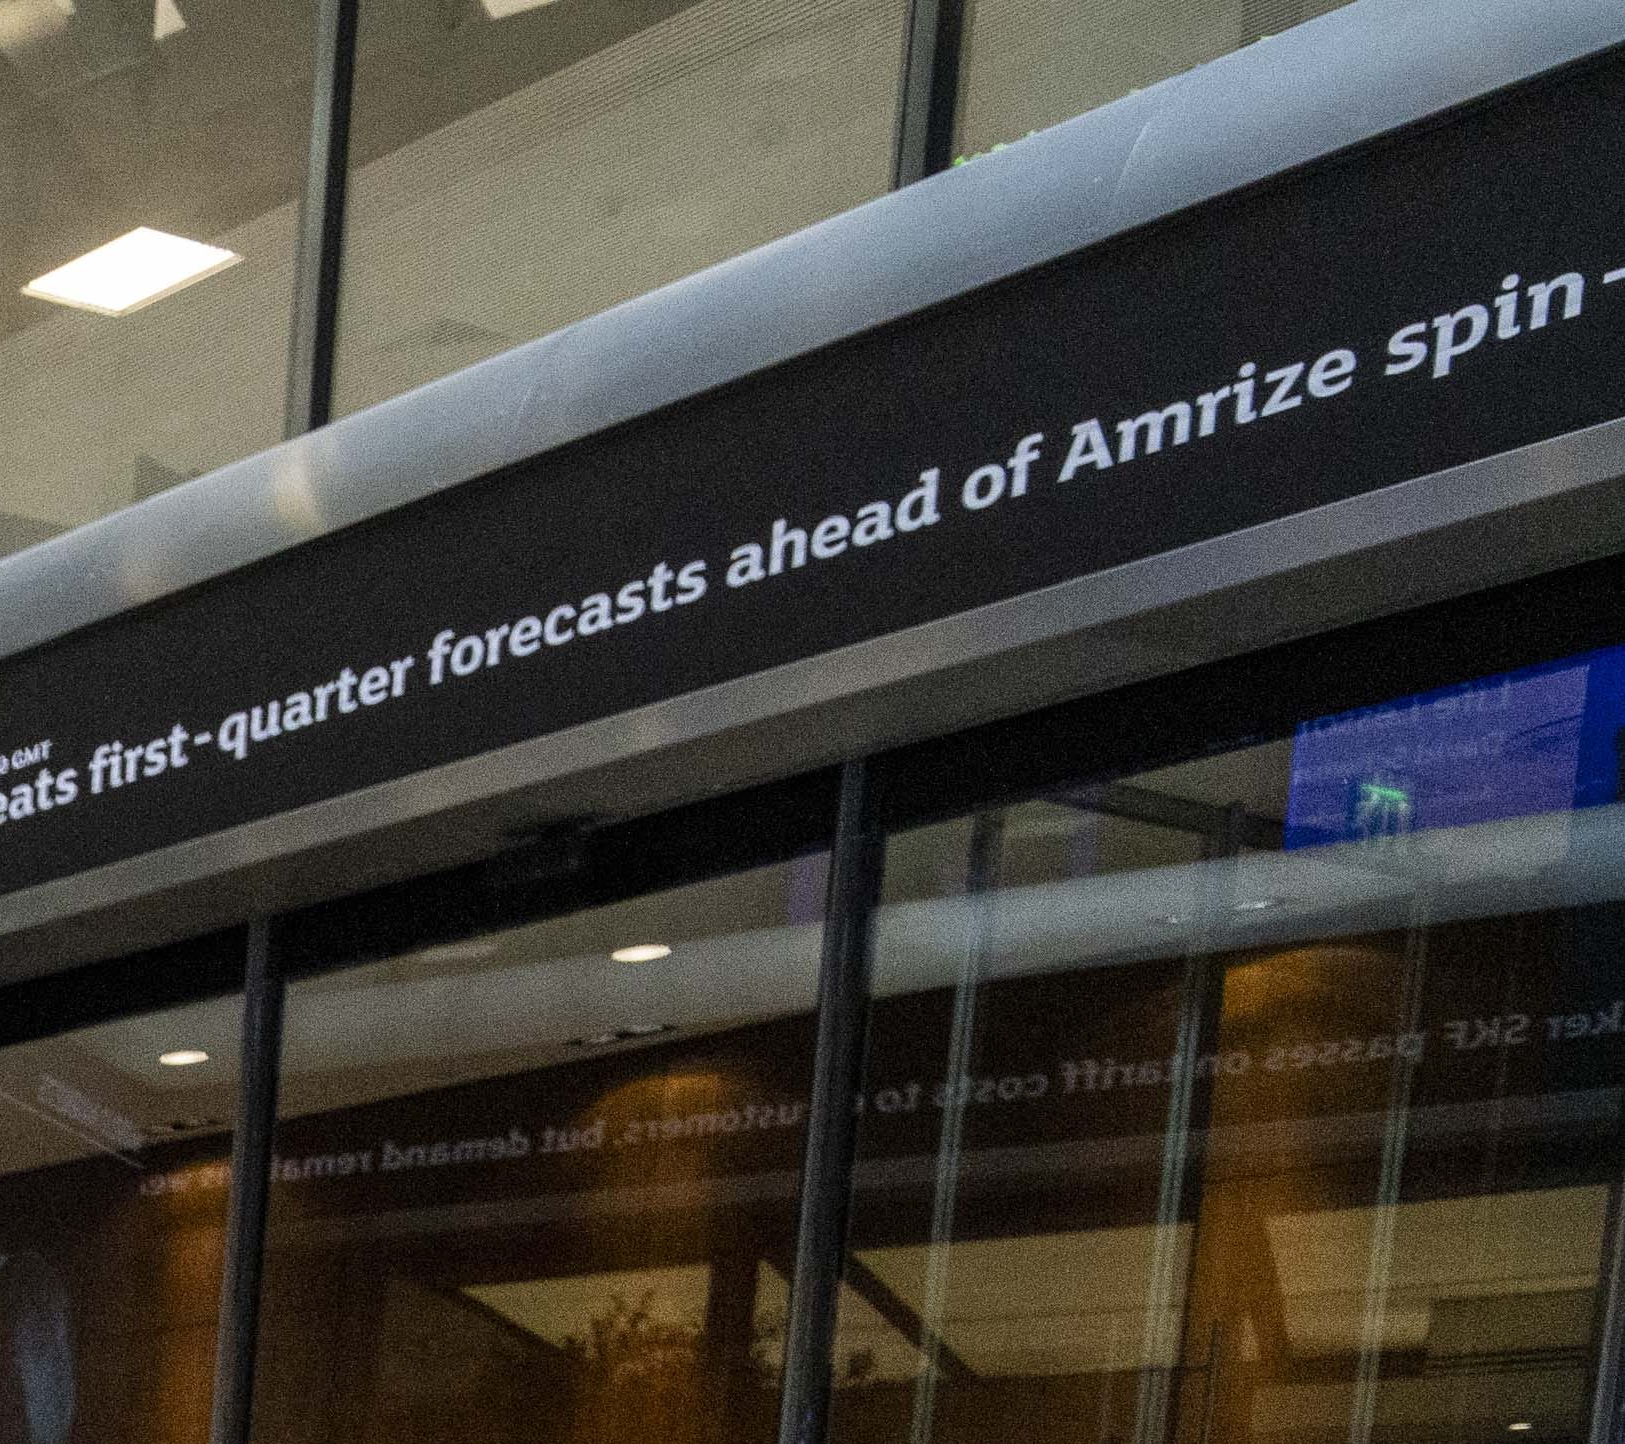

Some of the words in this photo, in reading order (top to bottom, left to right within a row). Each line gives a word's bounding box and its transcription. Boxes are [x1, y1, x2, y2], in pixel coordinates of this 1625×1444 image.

[89, 649, 415, 793] first-quarter
[427, 553, 708, 686] forecasts
[726, 467, 942, 589] ahead
[961, 432, 1044, 512] of
[1057, 346, 1358, 483] Amrize
[1383, 268, 1625, 379] spin-
[12, 739, 52, 771] GMT
